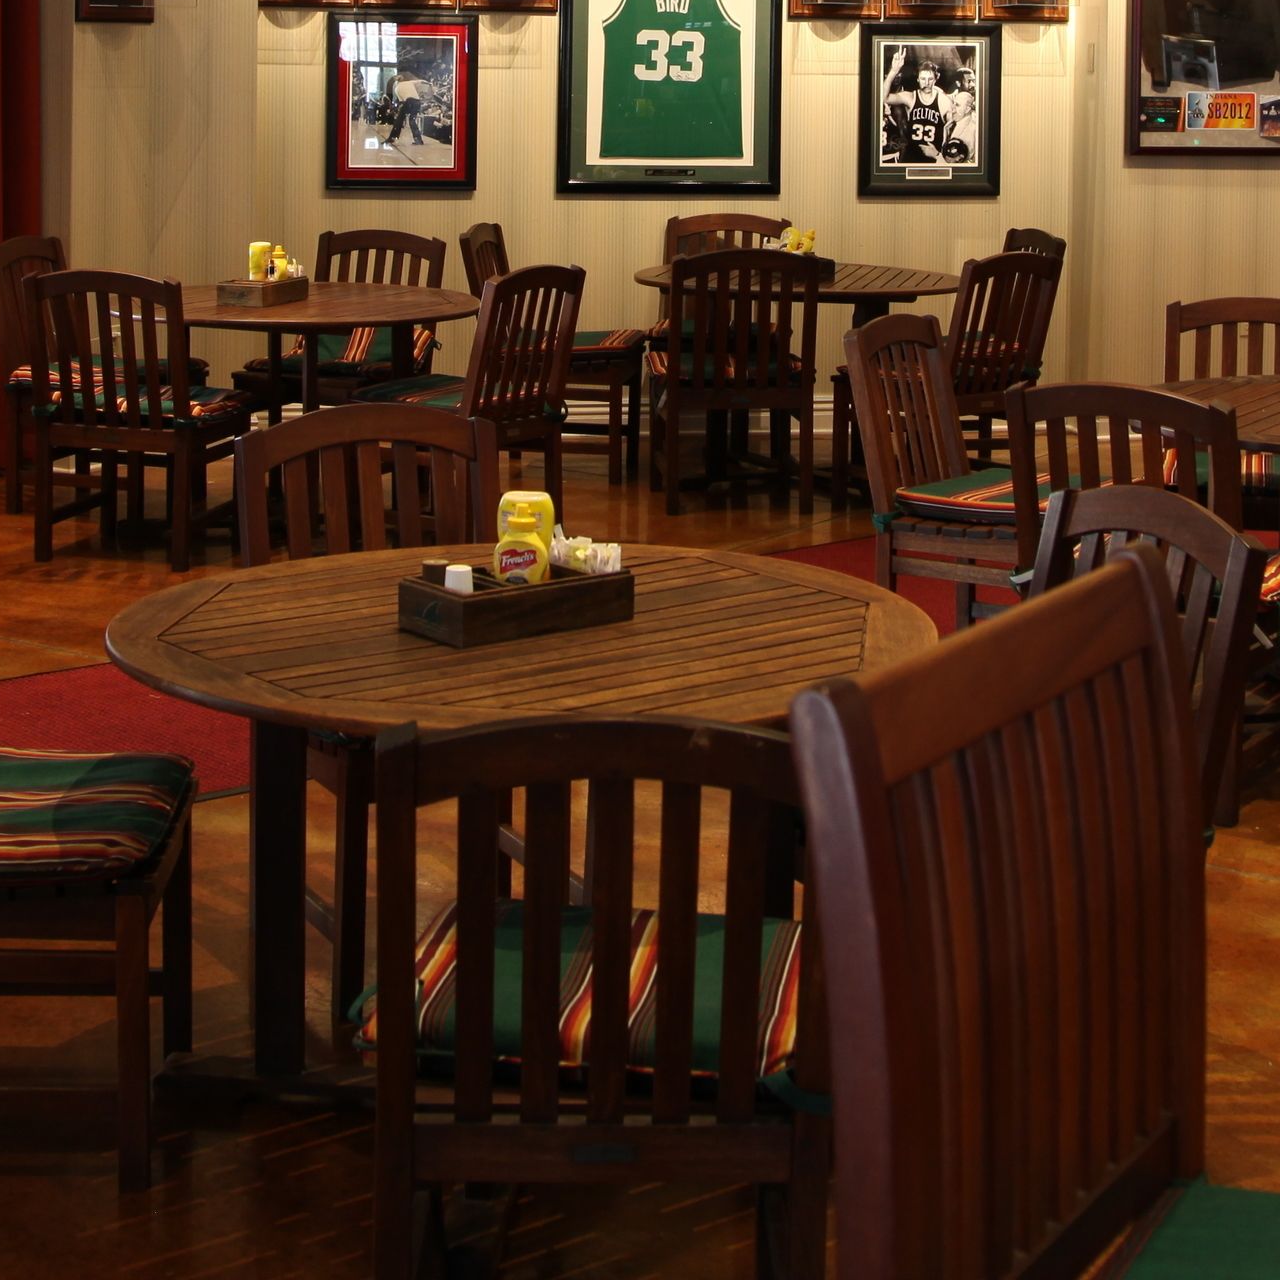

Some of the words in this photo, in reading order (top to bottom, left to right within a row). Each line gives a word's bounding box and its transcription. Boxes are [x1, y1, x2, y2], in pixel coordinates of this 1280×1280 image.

[634, 29, 705, 82] 33
[912, 107, 940, 124] CELTICS
[1207, 102, 1252, 120] SB2012
[911, 123, 936, 142] 33
[501, 551, 535, 568] French's
